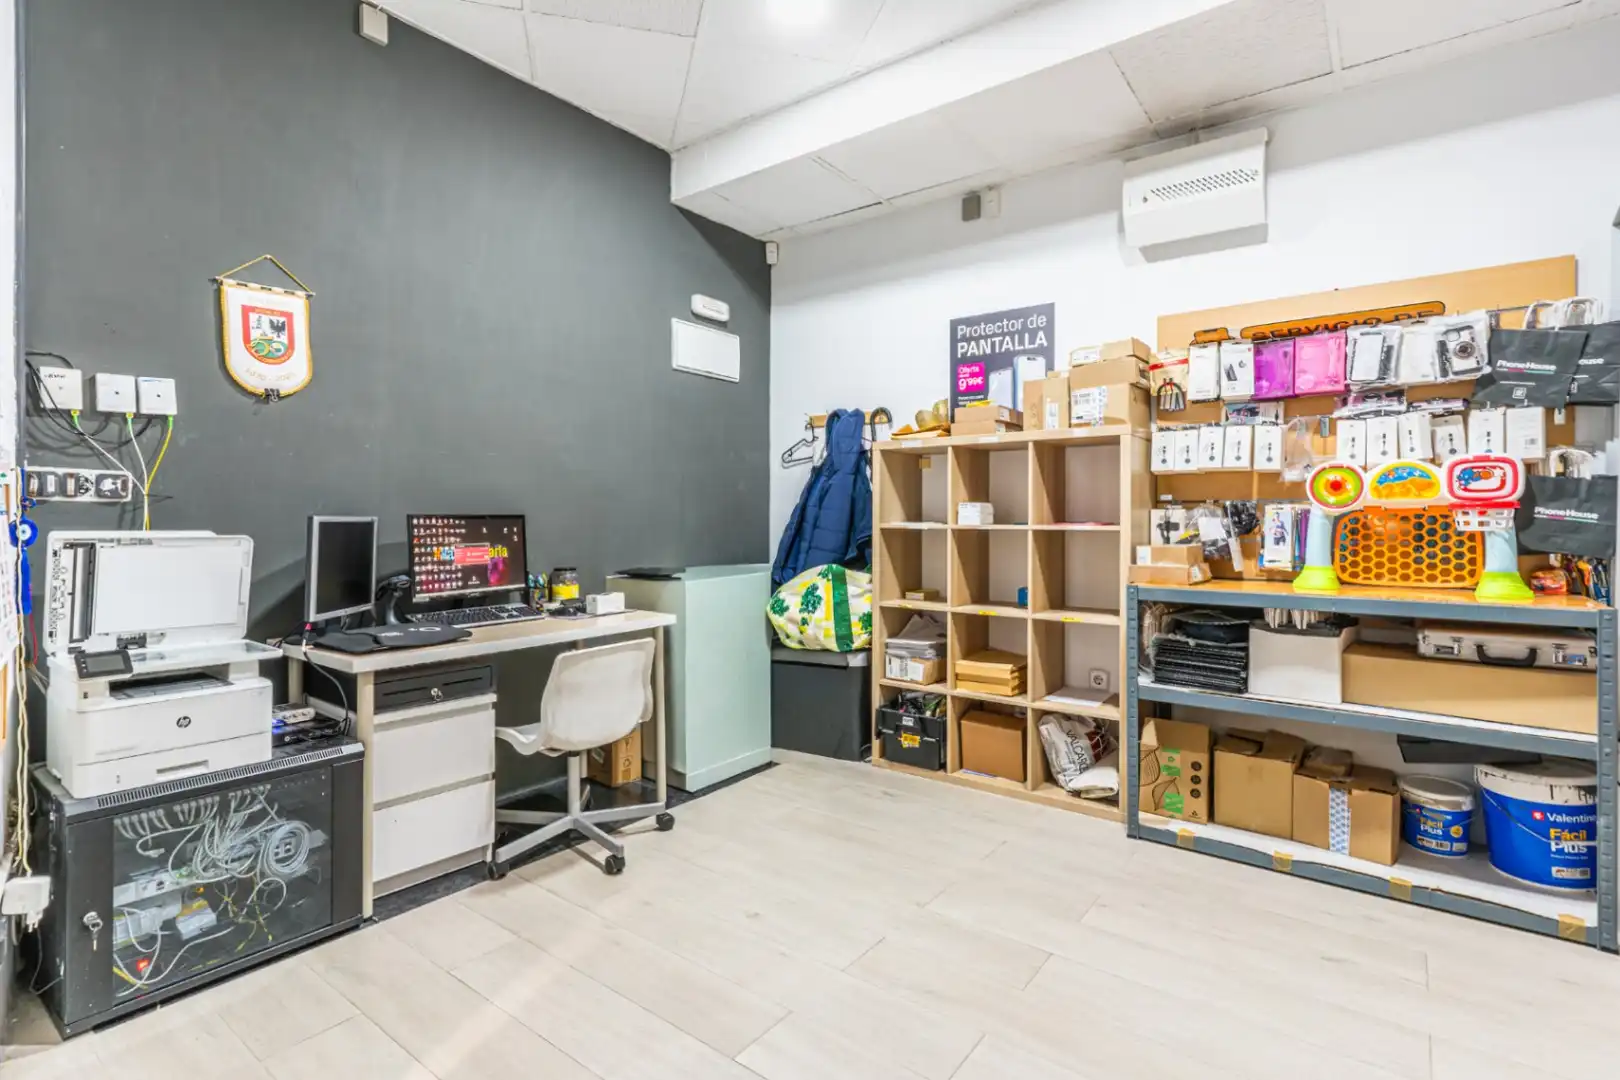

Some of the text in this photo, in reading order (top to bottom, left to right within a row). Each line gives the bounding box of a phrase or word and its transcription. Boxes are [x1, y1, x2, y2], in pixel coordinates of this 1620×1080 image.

[957, 314, 1047, 339] Protector de
[957, 331, 1047, 358] PANTALLA
[1549, 828, 1587, 841] Fácil
[1550, 840, 1588, 853] Plus
